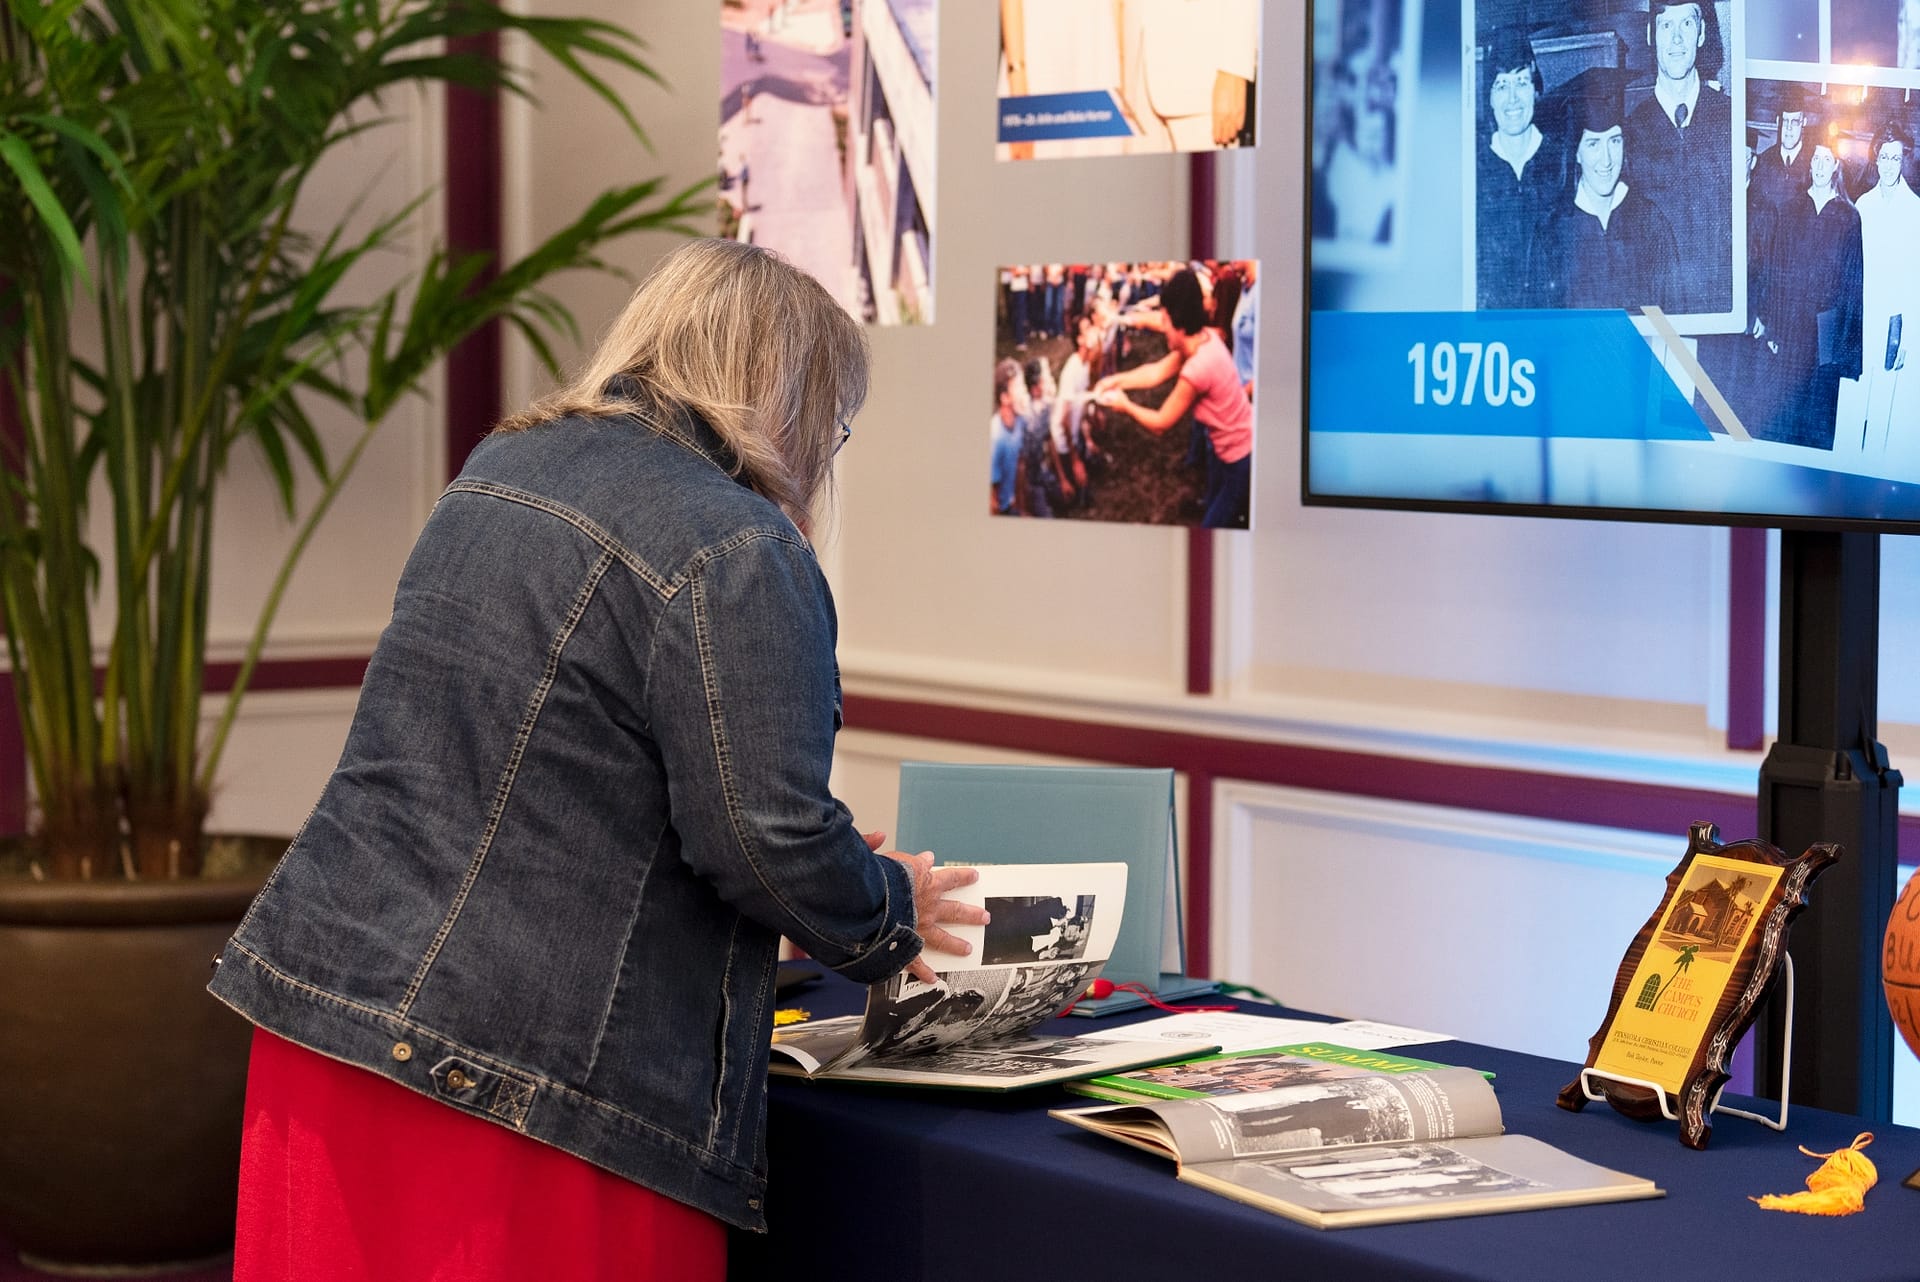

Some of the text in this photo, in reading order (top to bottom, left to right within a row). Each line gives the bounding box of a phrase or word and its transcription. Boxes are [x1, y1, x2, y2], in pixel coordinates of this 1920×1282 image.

[1408, 342, 1536, 407] 1970s
[1672, 976, 1694, 990] THE
[1663, 989, 1703, 1007] CAMPUS
[1657, 1003, 1698, 1022] CHURCH
[1641, 1037, 1668, 1049] CHRISTIAN
[1440, 1095, 1452, 1111] Past
[1446, 1113, 1455, 1138] Years
